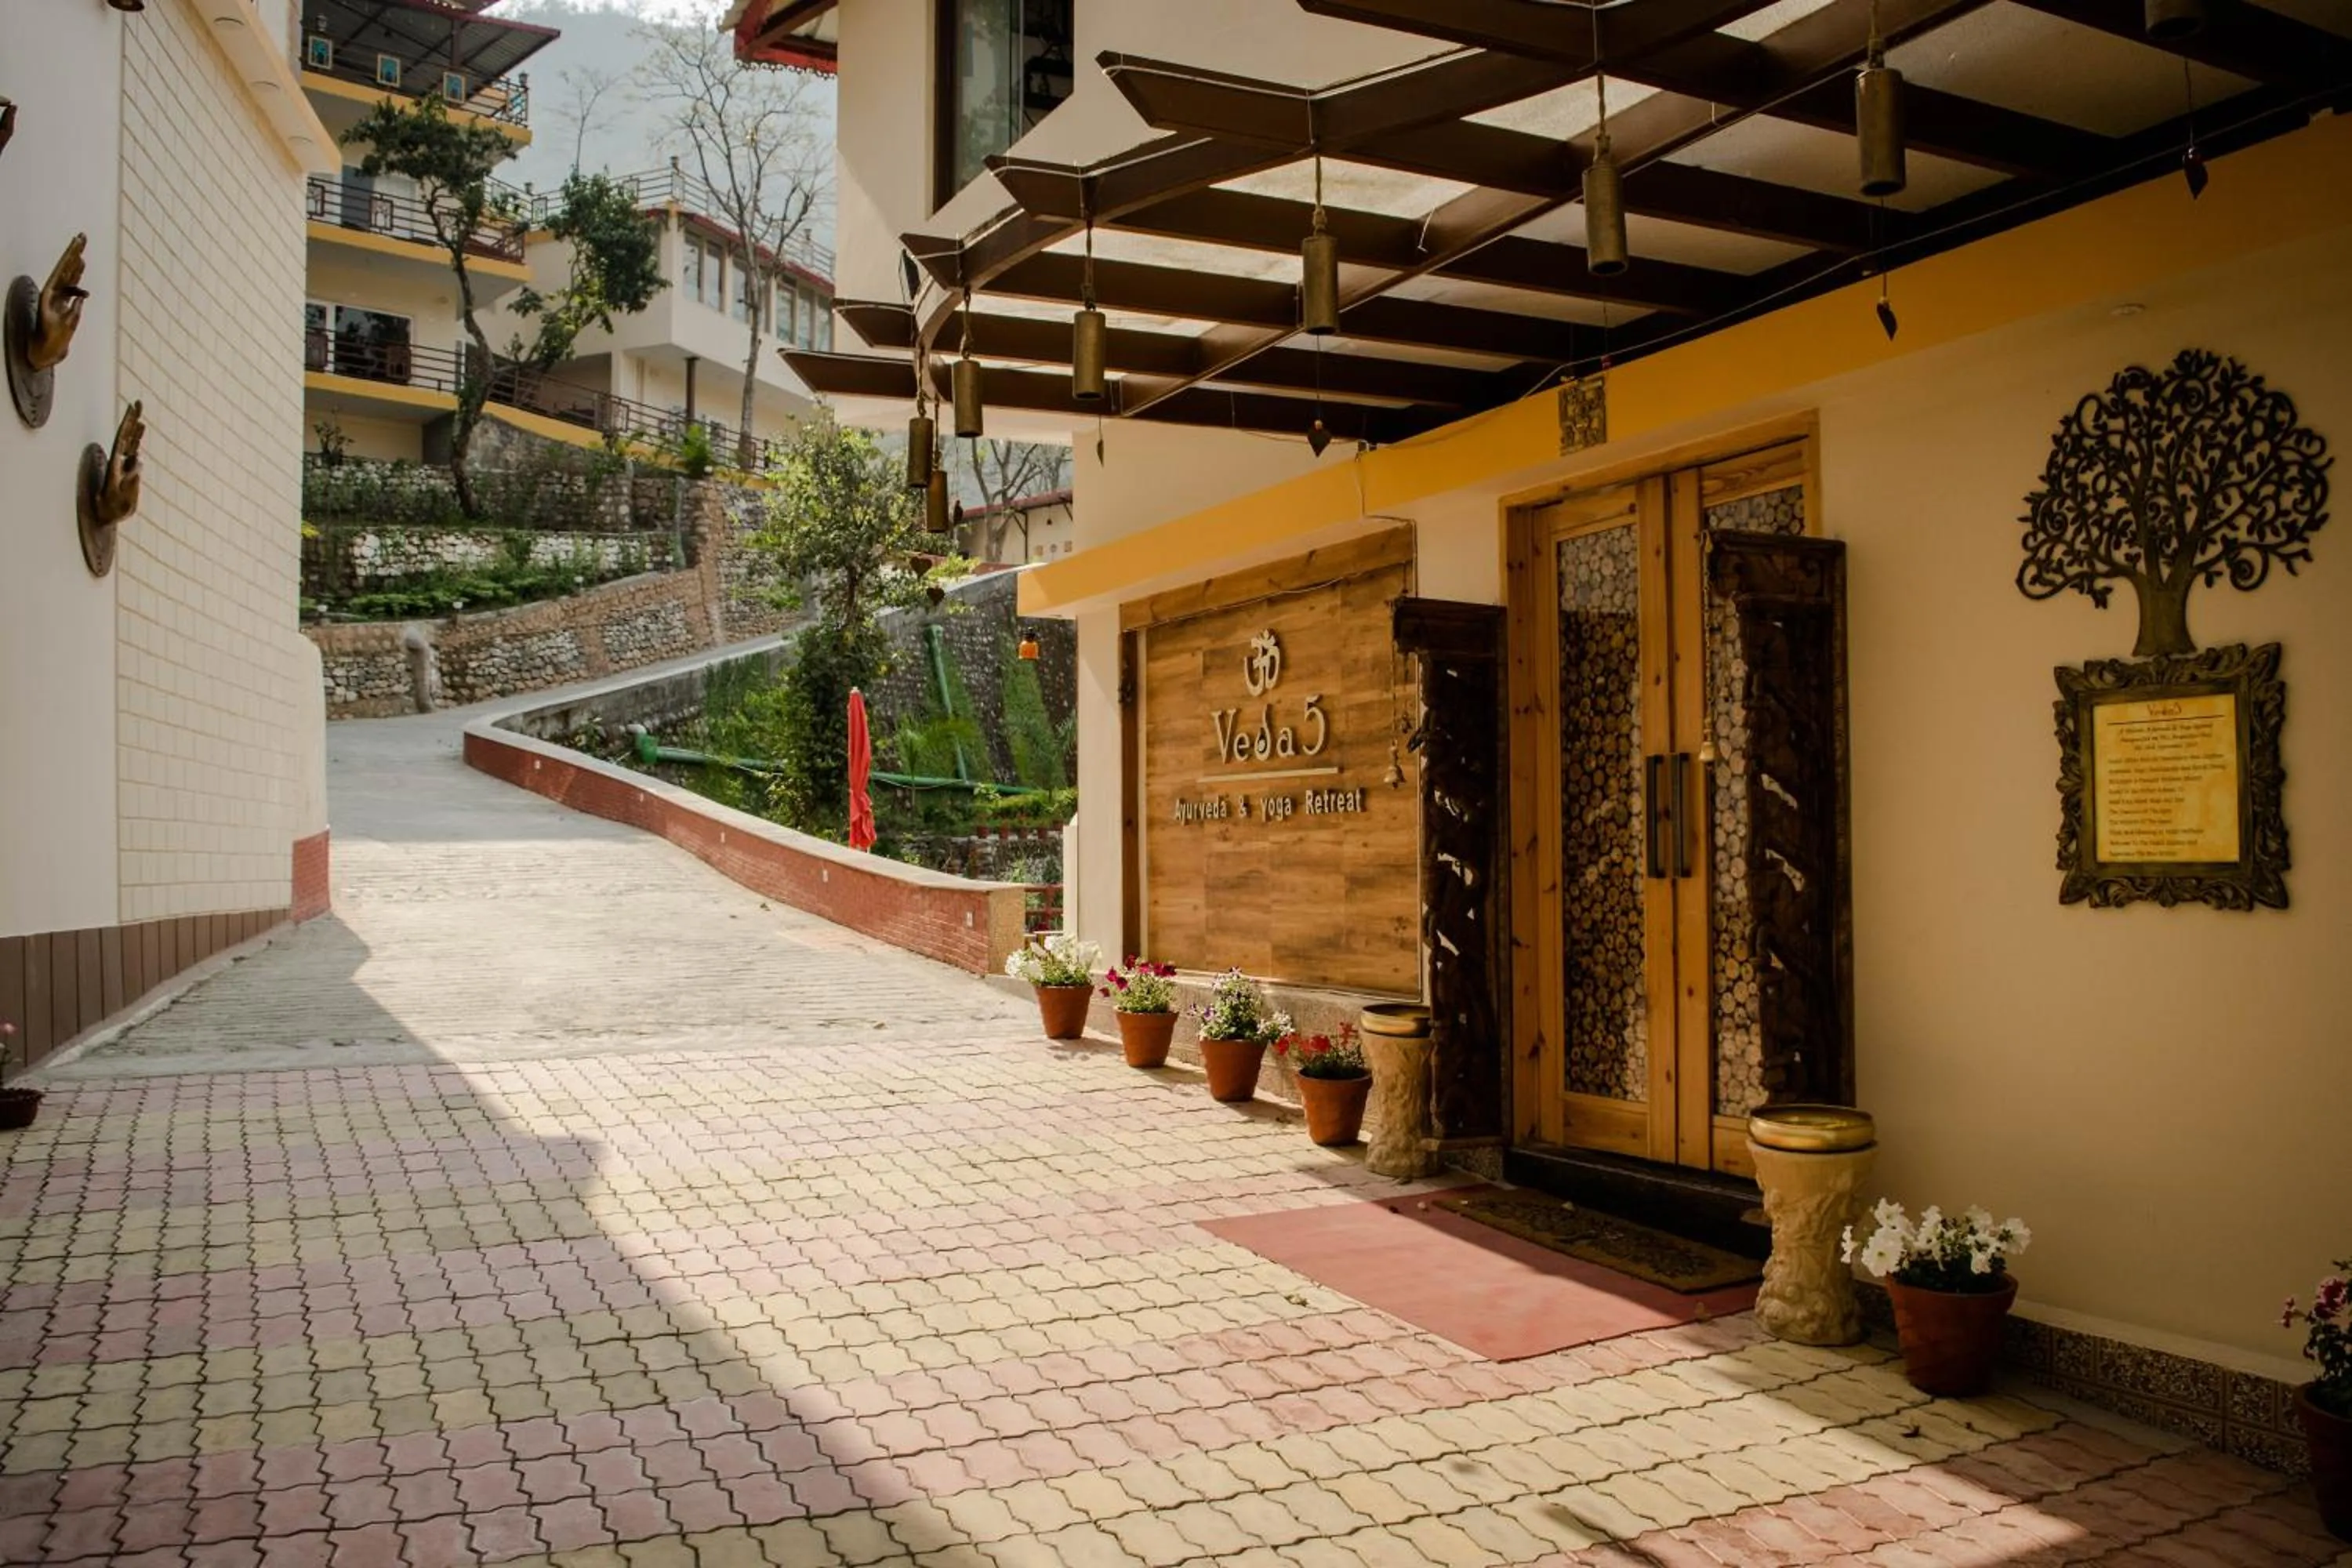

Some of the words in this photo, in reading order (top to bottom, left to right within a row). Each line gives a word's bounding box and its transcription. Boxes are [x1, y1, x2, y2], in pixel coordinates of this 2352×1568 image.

[1174, 795, 1228, 826] Ayurveda
[1238, 794, 1248, 818] &
[1305, 788, 1363, 815] Retreat
